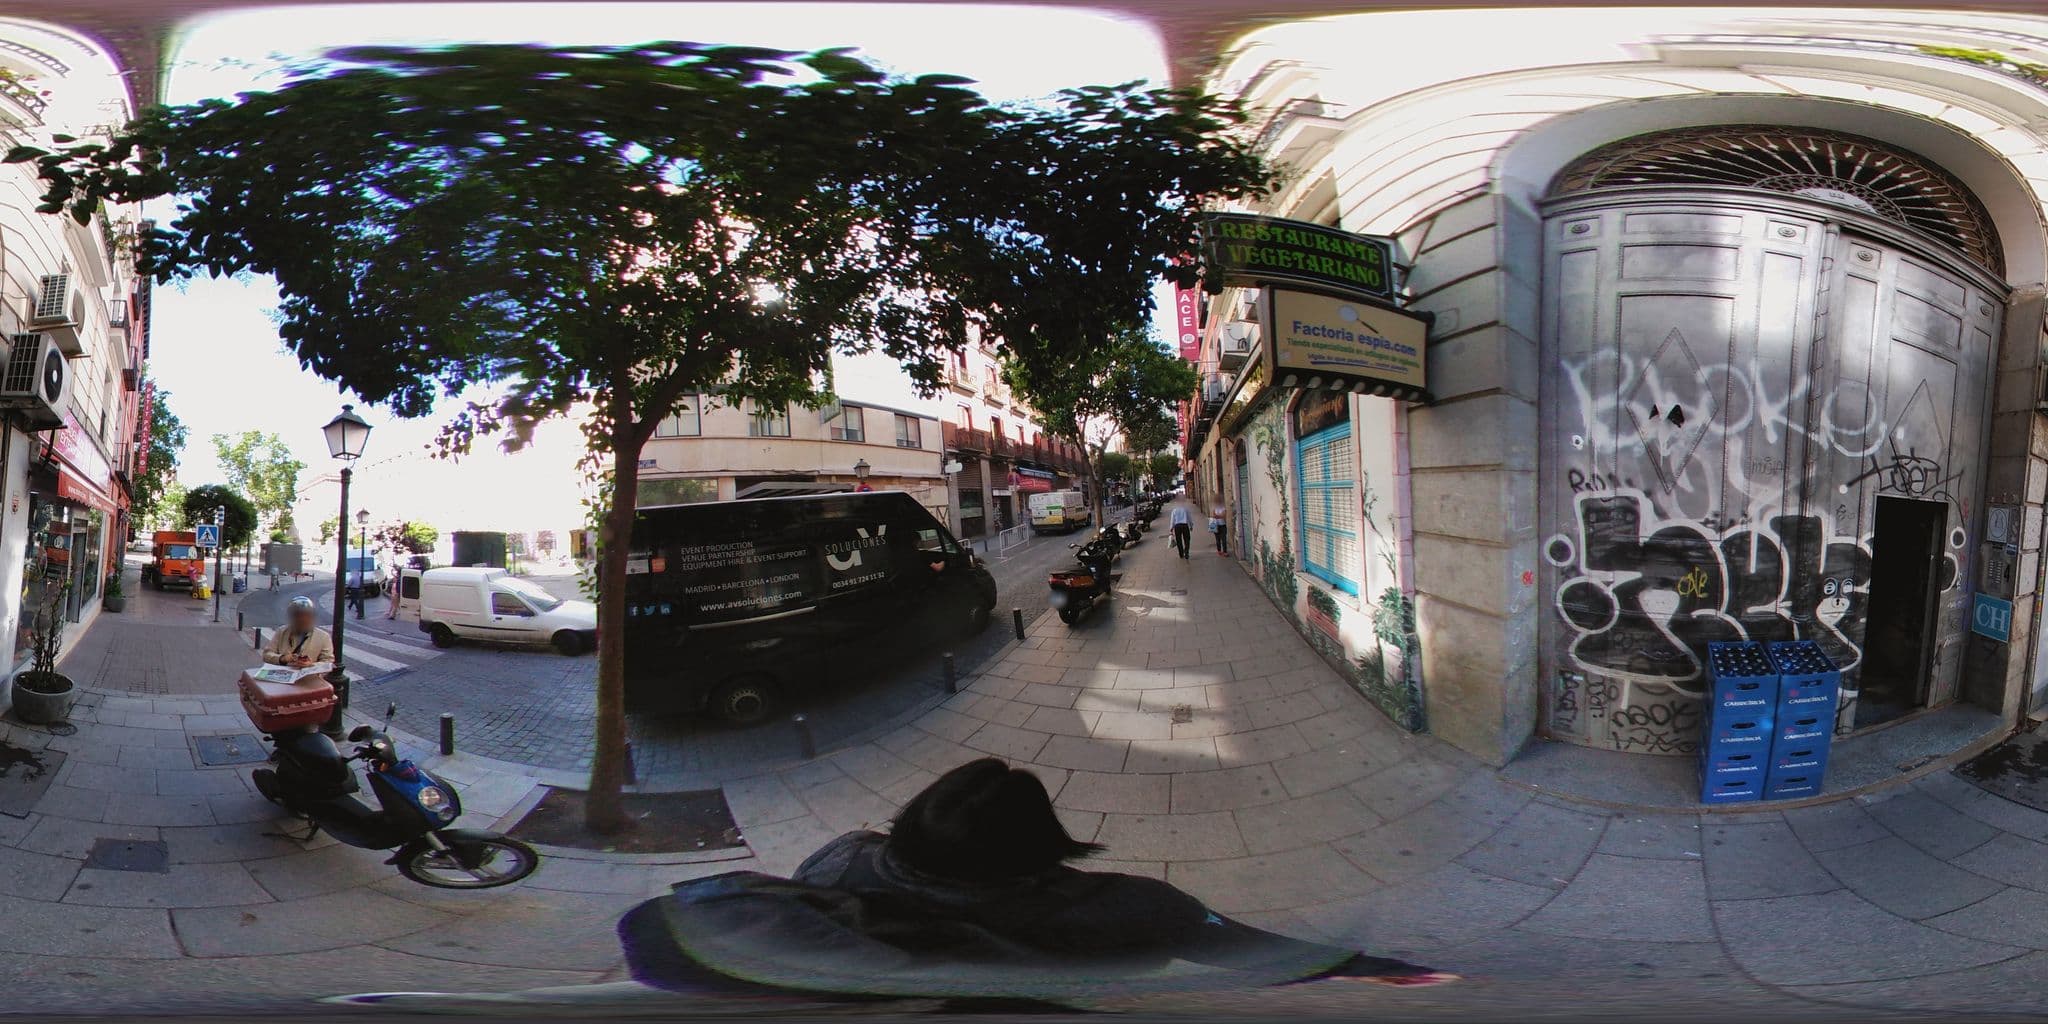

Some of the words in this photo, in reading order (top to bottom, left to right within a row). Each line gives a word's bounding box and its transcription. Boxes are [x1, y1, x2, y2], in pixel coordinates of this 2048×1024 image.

[1220, 222, 1380, 265] RESTAURANTE
[1227, 244, 1380, 287] VEGETARIANO
[1179, 289, 1193, 327] ACE
[1292, 320, 1354, 342] Factoria
[1358, 334, 1417, 357] espia.com
[144, 387, 152, 417] PETIT
[141, 420, 149, 457] PALACE
[681, 545, 705, 555] EVENT
[706, 541, 753, 551] PRODUCTION
[681, 553, 707, 563] VENUE
[708, 549, 756, 561] PARTNERSHIP
[825, 535, 887, 555] SOLUCIONES
[682, 559, 727, 571] EQUIPMENT
[728, 558, 745, 567] HIRE
[753, 553, 778, 564] EVENT
[777, 550, 807, 560] SUPPORT
[685, 585, 716, 595] MADRID
[722, 578, 764, 591] BARCELONA
[769, 573, 800, 584] LONDON
[832, 580, 849, 589] 0034
[849, 578, 857, 586] 91
[700, 590, 802, 612] www.avsoluciones.com
[1976, 603, 2008, 633] CH
